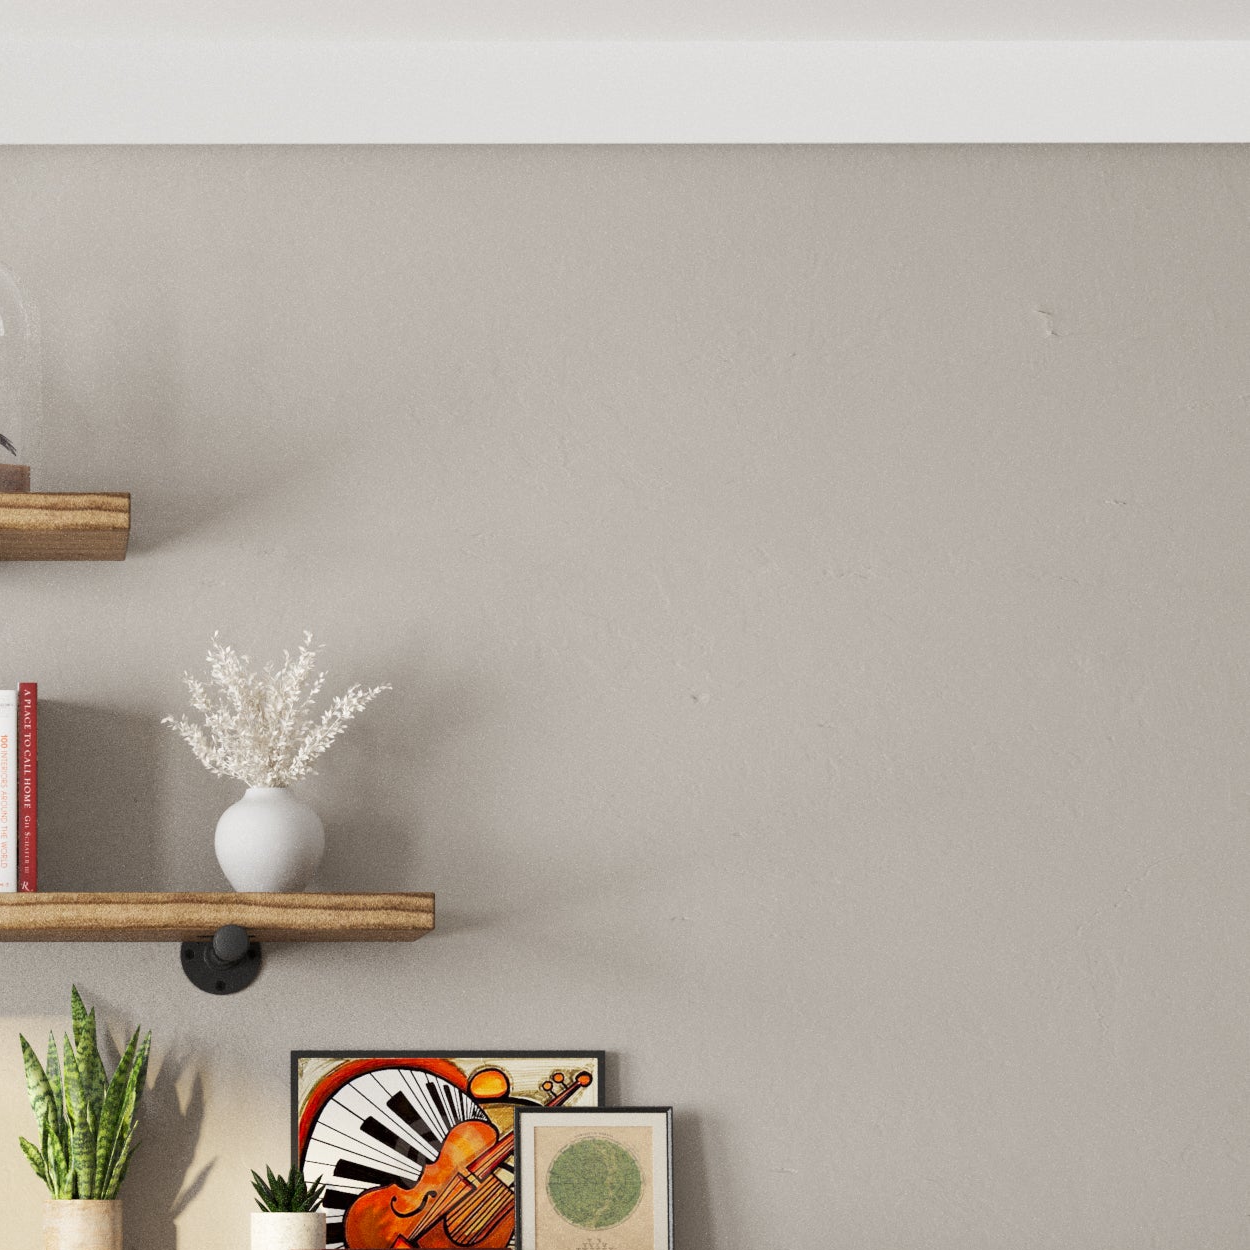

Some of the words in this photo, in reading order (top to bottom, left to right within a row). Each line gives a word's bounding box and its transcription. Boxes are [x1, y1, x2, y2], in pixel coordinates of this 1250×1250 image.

[24, 689, 32, 697] A
[24, 698, 32, 730] PLACE
[0, 734, 8, 748] 100
[24, 732, 32, 748] TO
[0, 750, 8, 788] INTERIORS
[24, 750, 32, 776] CALL
[24, 778, 32, 809] HOME
[0, 790, 8, 824] AROUND
[0, 826, 8, 838] THE
[0, 841, 8, 868] WORLD
